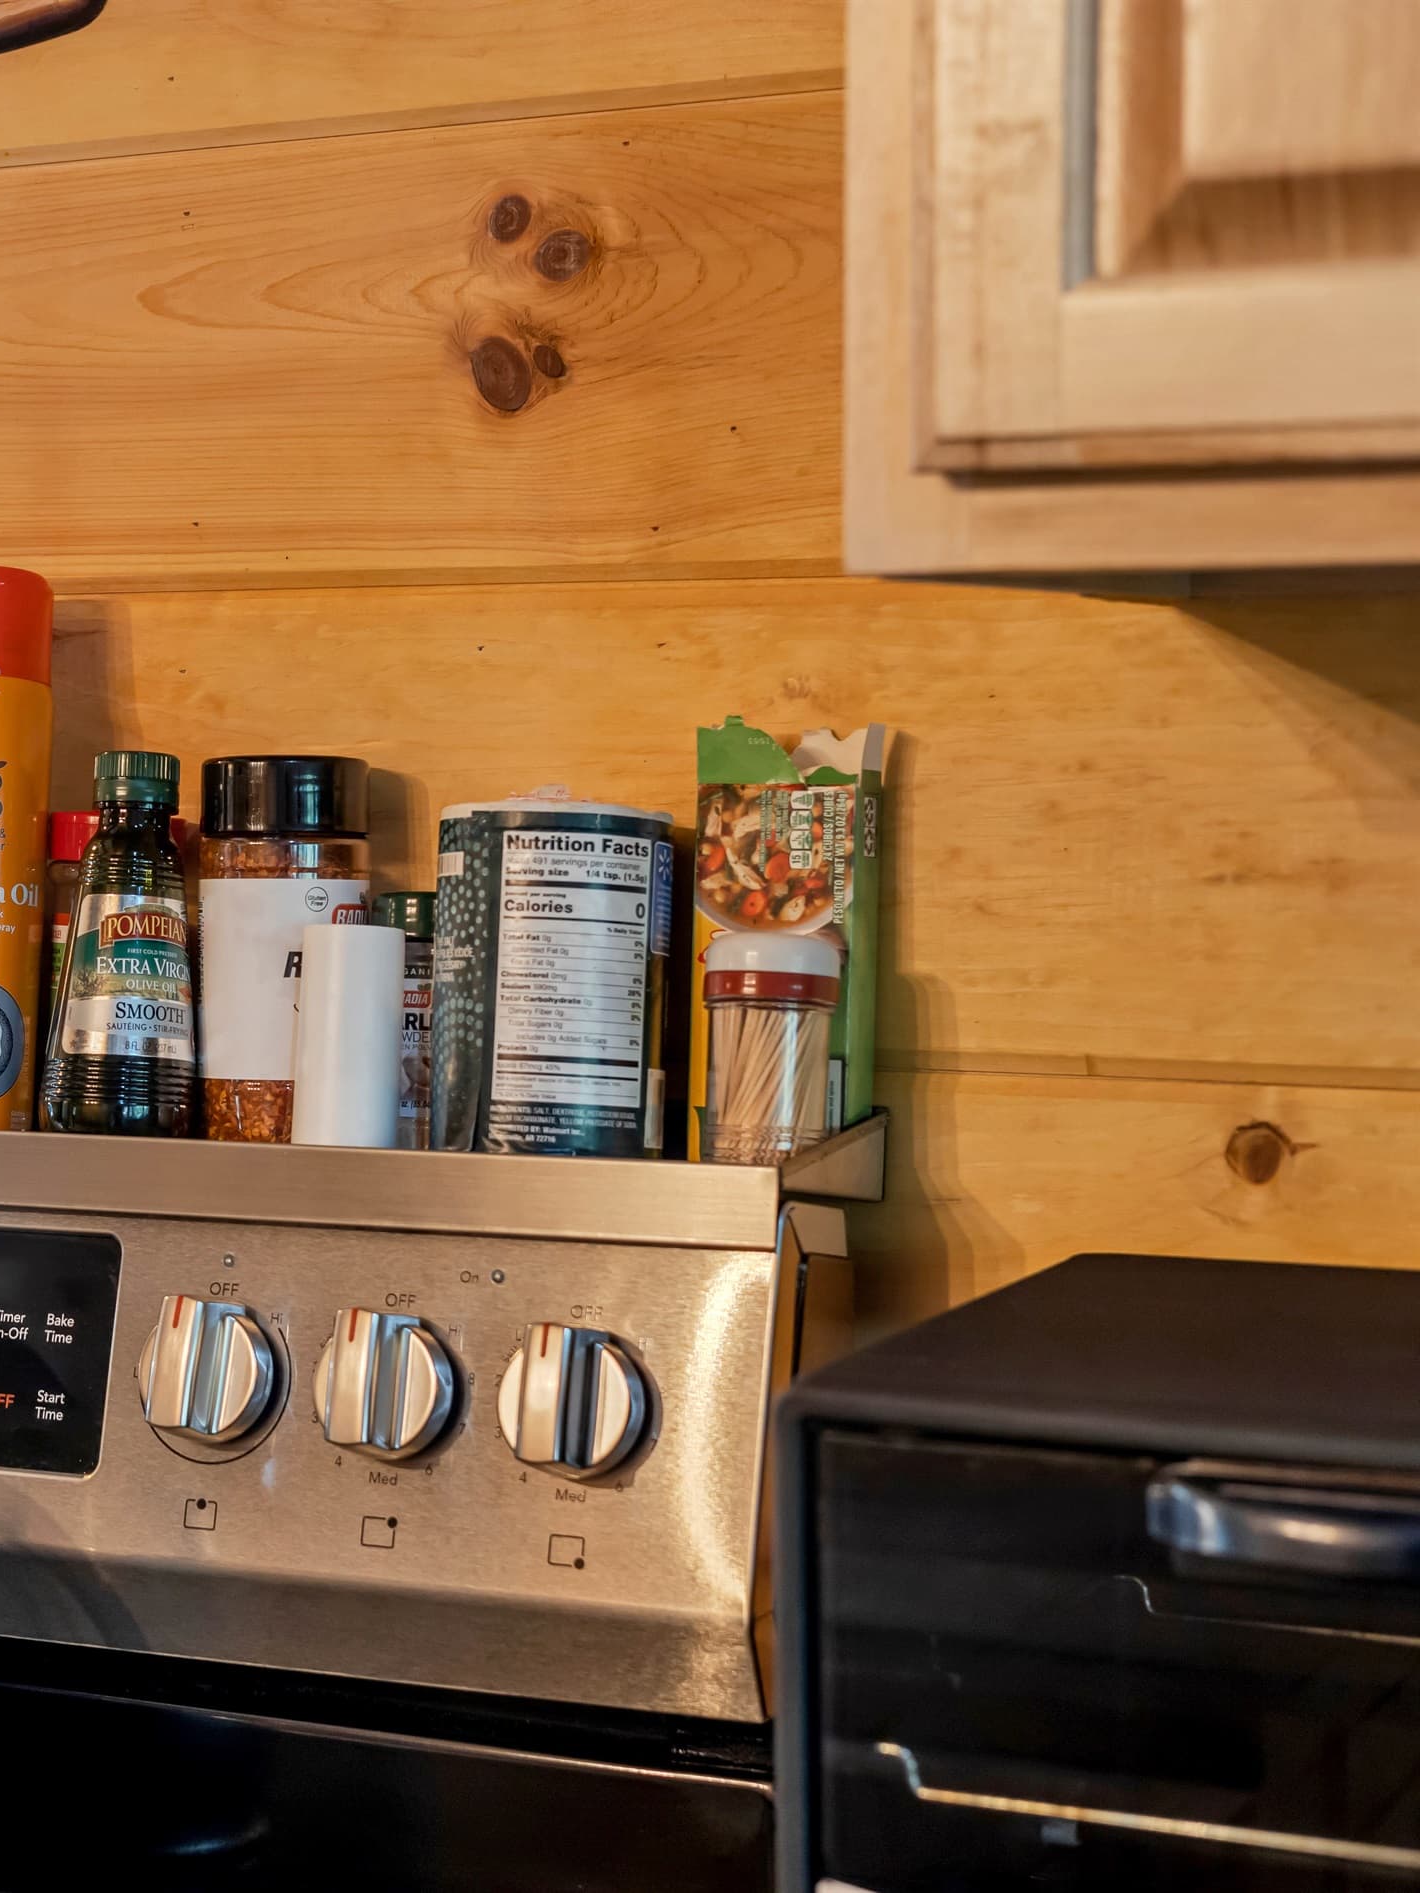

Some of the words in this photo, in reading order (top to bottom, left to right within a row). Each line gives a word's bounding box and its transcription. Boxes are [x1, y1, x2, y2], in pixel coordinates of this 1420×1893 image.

[836, 815, 846, 827] OZ
[823, 823, 834, 850] CUBOS
[506, 834, 595, 853] Nutrition
[601, 838, 649, 857] Facts
[550, 857, 587, 868] servings
[590, 861, 604, 869] per
[791, 855, 800, 864] 15
[834, 858, 845, 874] NET
[547, 868, 569, 876] size
[11, 882, 39, 908] Oil
[833, 879, 845, 902] NETO
[504, 899, 573, 913] Calories
[635, 902, 646, 919] 0
[832, 902, 844, 924] PESO
[107, 914, 187, 944] POMPEIAN
[127, 947, 142, 955] FIRST
[142, 948, 158, 956] COLD
[96, 956, 151, 976] EXTRA
[153, 957, 191, 981] VIRGIN
[283, 951, 303, 978] R
[126, 978, 158, 990] OLIVE
[161, 983, 177, 994] OIL
[405, 993, 428, 1005] ADIA
[523, 995, 581, 1005] Carbohydrate
[115, 1001, 184, 1025] SMOOTH
[534, 1007, 552, 1015] Fiber
[403, 1012, 433, 1031] RLI
[402, 1031, 432, 1043] WDE
[459, 1270, 479, 1284] On
[209, 1281, 240, 1297] OFF
[384, 1292, 417, 1308] OFF
[46, 1312, 75, 1328] Bake
[270, 1312, 284, 1325] Hi
[569, 1304, 604, 1321] OFF
[44, 1329, 73, 1344] Time
[447, 1325, 462, 1338] Hi
[467, 1372, 476, 1386] 8
[494, 1374, 503, 1387] 2
[37, 1389, 66, 1405] Start
[35, 1406, 64, 1421] Time
[311, 1411, 319, 1424] 3
[459, 1421, 467, 1435] 7
[494, 1426, 503, 1440] 3
[334, 1455, 343, 1468] 4
[424, 1464, 434, 1477] 6
[518, 1470, 528, 1484] 4
[368, 1470, 399, 1487] Med
[555, 1487, 587, 1504] Med
